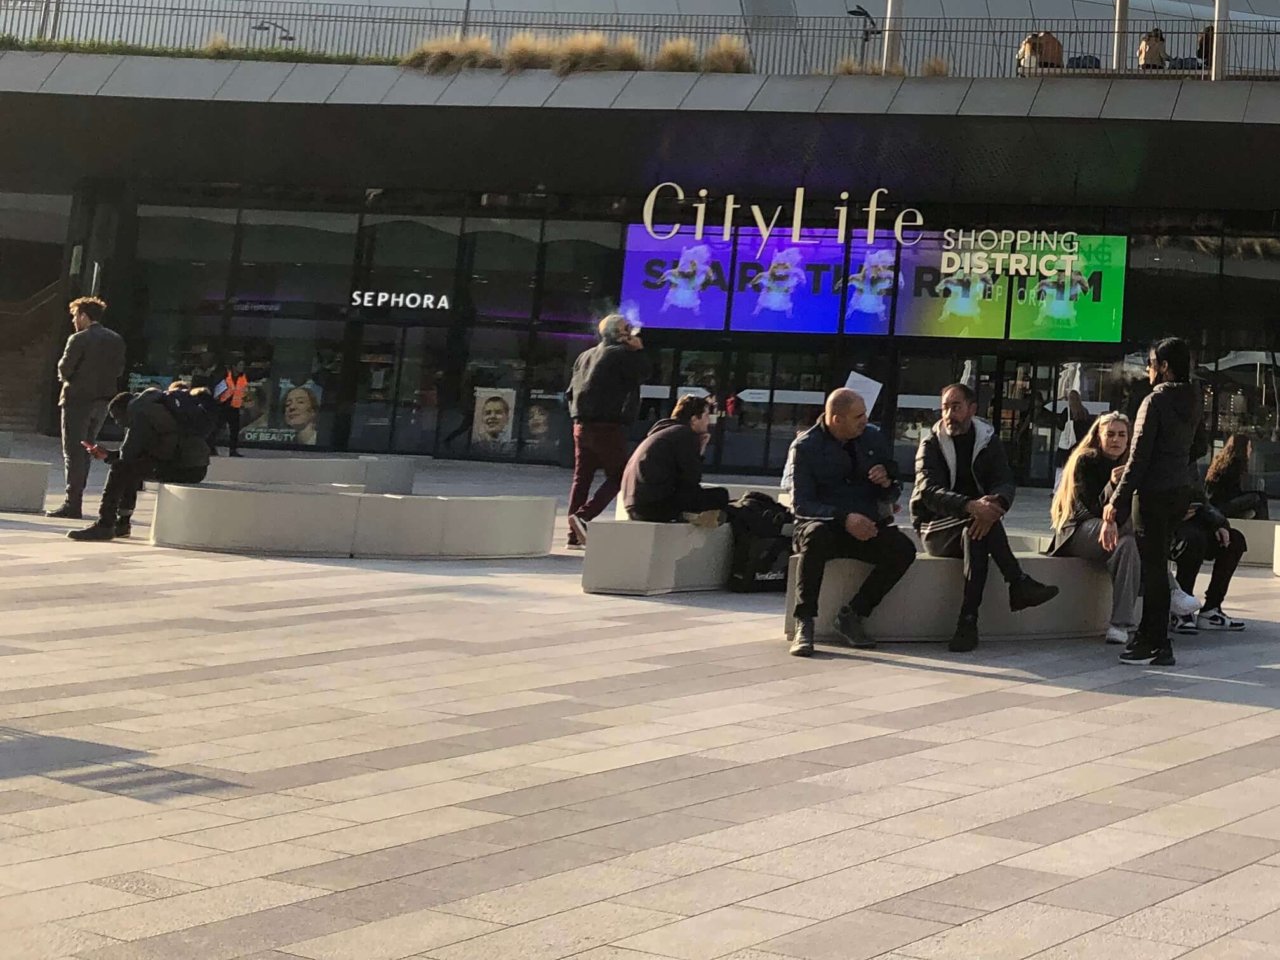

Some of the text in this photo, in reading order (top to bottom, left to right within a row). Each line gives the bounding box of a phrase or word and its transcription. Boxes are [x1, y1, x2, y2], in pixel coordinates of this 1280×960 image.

[642, 182, 924, 260] CityLife
[942, 229, 1079, 252] SHOPPING
[940, 252, 1080, 276] DISTRICT
[352, 291, 450, 310] SEPHORA
[245, 432, 296, 441] OF BEAUTY
